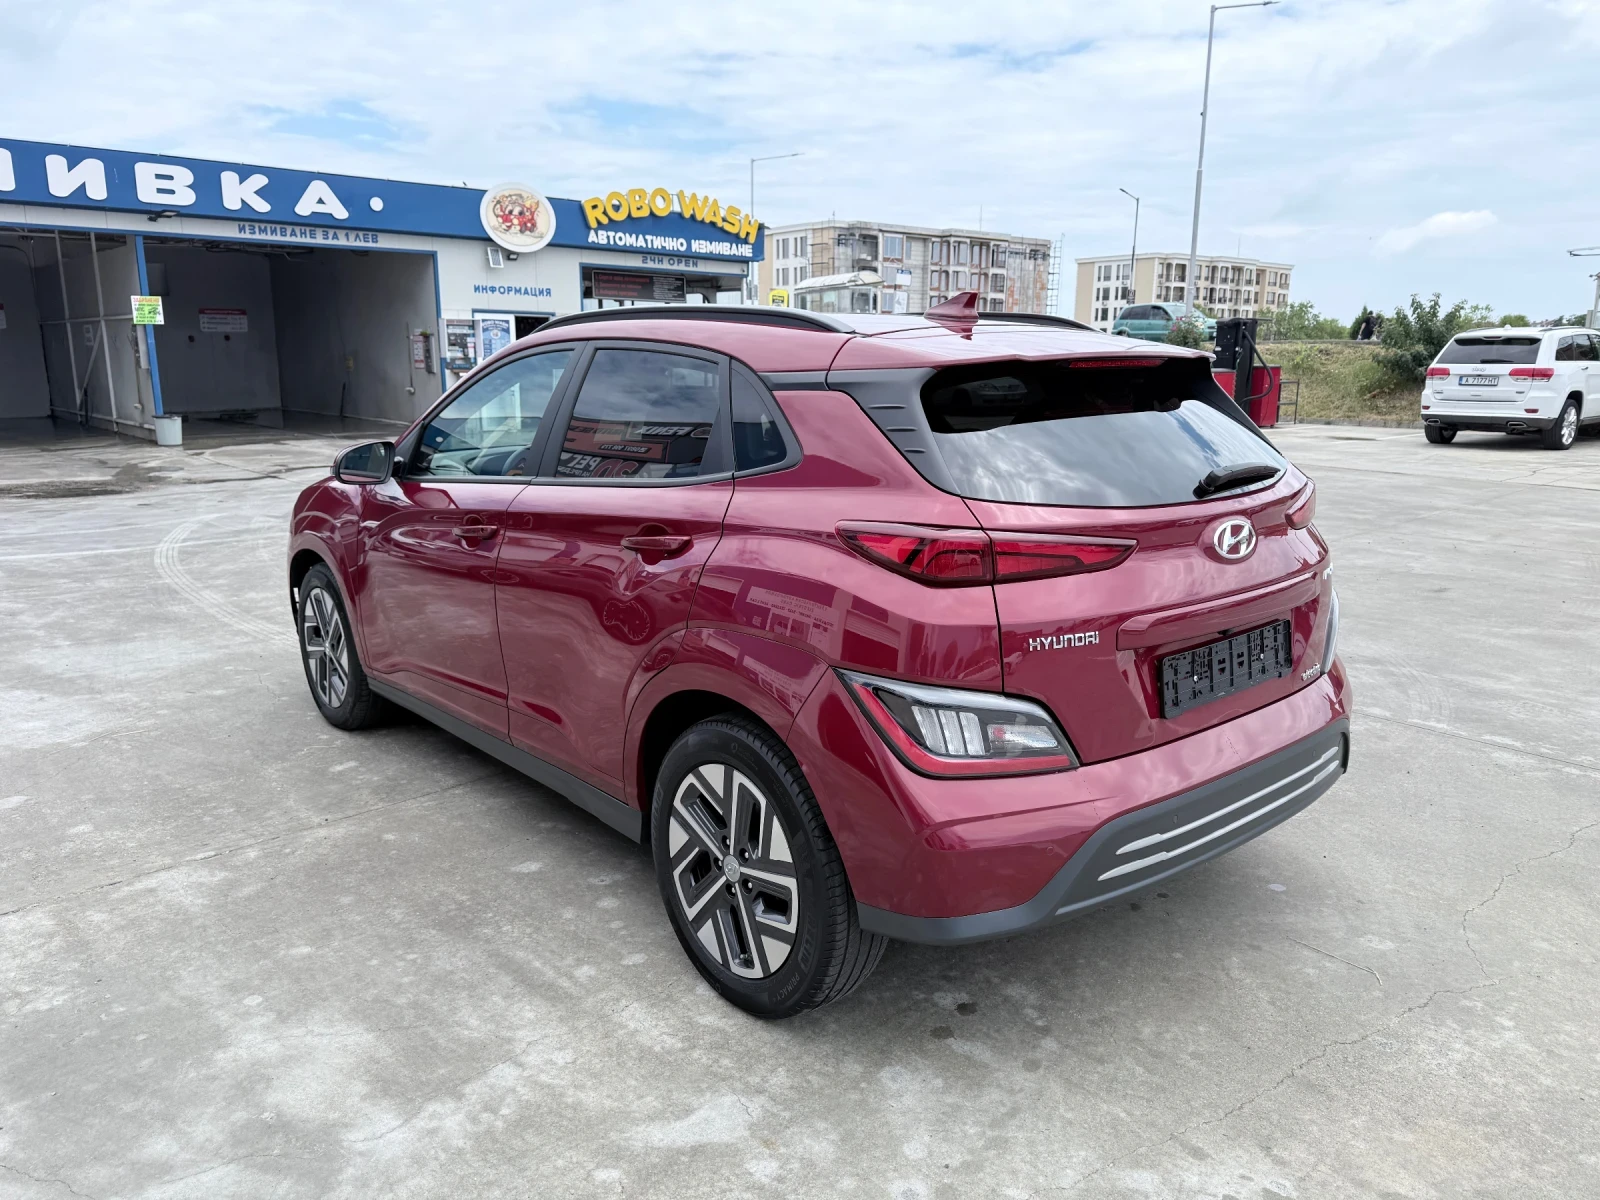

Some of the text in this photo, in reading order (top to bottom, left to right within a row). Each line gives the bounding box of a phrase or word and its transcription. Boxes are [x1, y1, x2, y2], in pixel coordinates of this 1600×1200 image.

[581, 187, 759, 244] ROBO WASH
[237, 223, 379, 243] ИЗМИВАНЕ ЗА 1 ЛЕВ
[588, 229, 753, 257] АВТОМАТИЧНО ИЗМИВАНЕ
[668, 257, 698, 269] OPEN
[473, 284, 551, 298] ИНФОРМАЦИЯ
[1029, 630, 1099, 652] HYUNDAI
[776, 971, 800, 1001] PRIMACY
